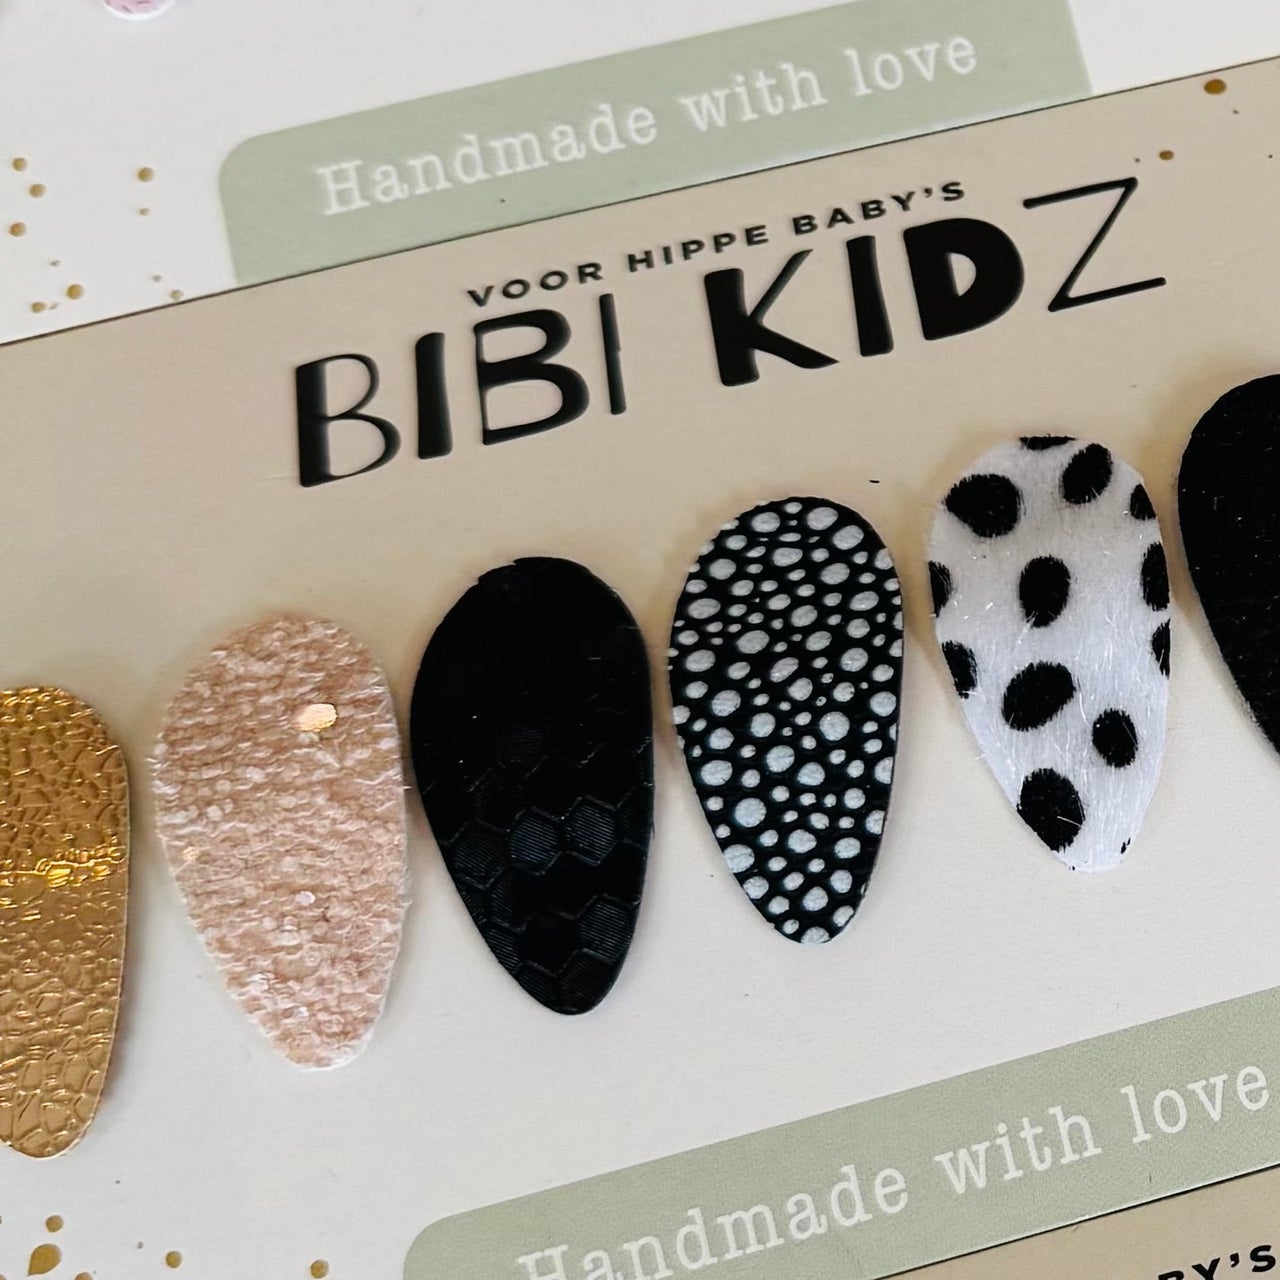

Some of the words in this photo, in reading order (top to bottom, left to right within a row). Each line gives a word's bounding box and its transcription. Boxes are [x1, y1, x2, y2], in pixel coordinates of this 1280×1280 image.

[316, 103, 659, 215] Handmade
[679, 62, 828, 133] with
[844, 35, 978, 97] love
[467, 261, 604, 309] VOOR
[626, 225, 769, 274] HIPPE
[792, 181, 965, 236] BABY'S
[295, 293, 627, 487] BIBI
[703, 176, 1167, 387] KIDZ
[935, 1104, 1102, 1196] with
[1120, 1063, 1272, 1145] love
